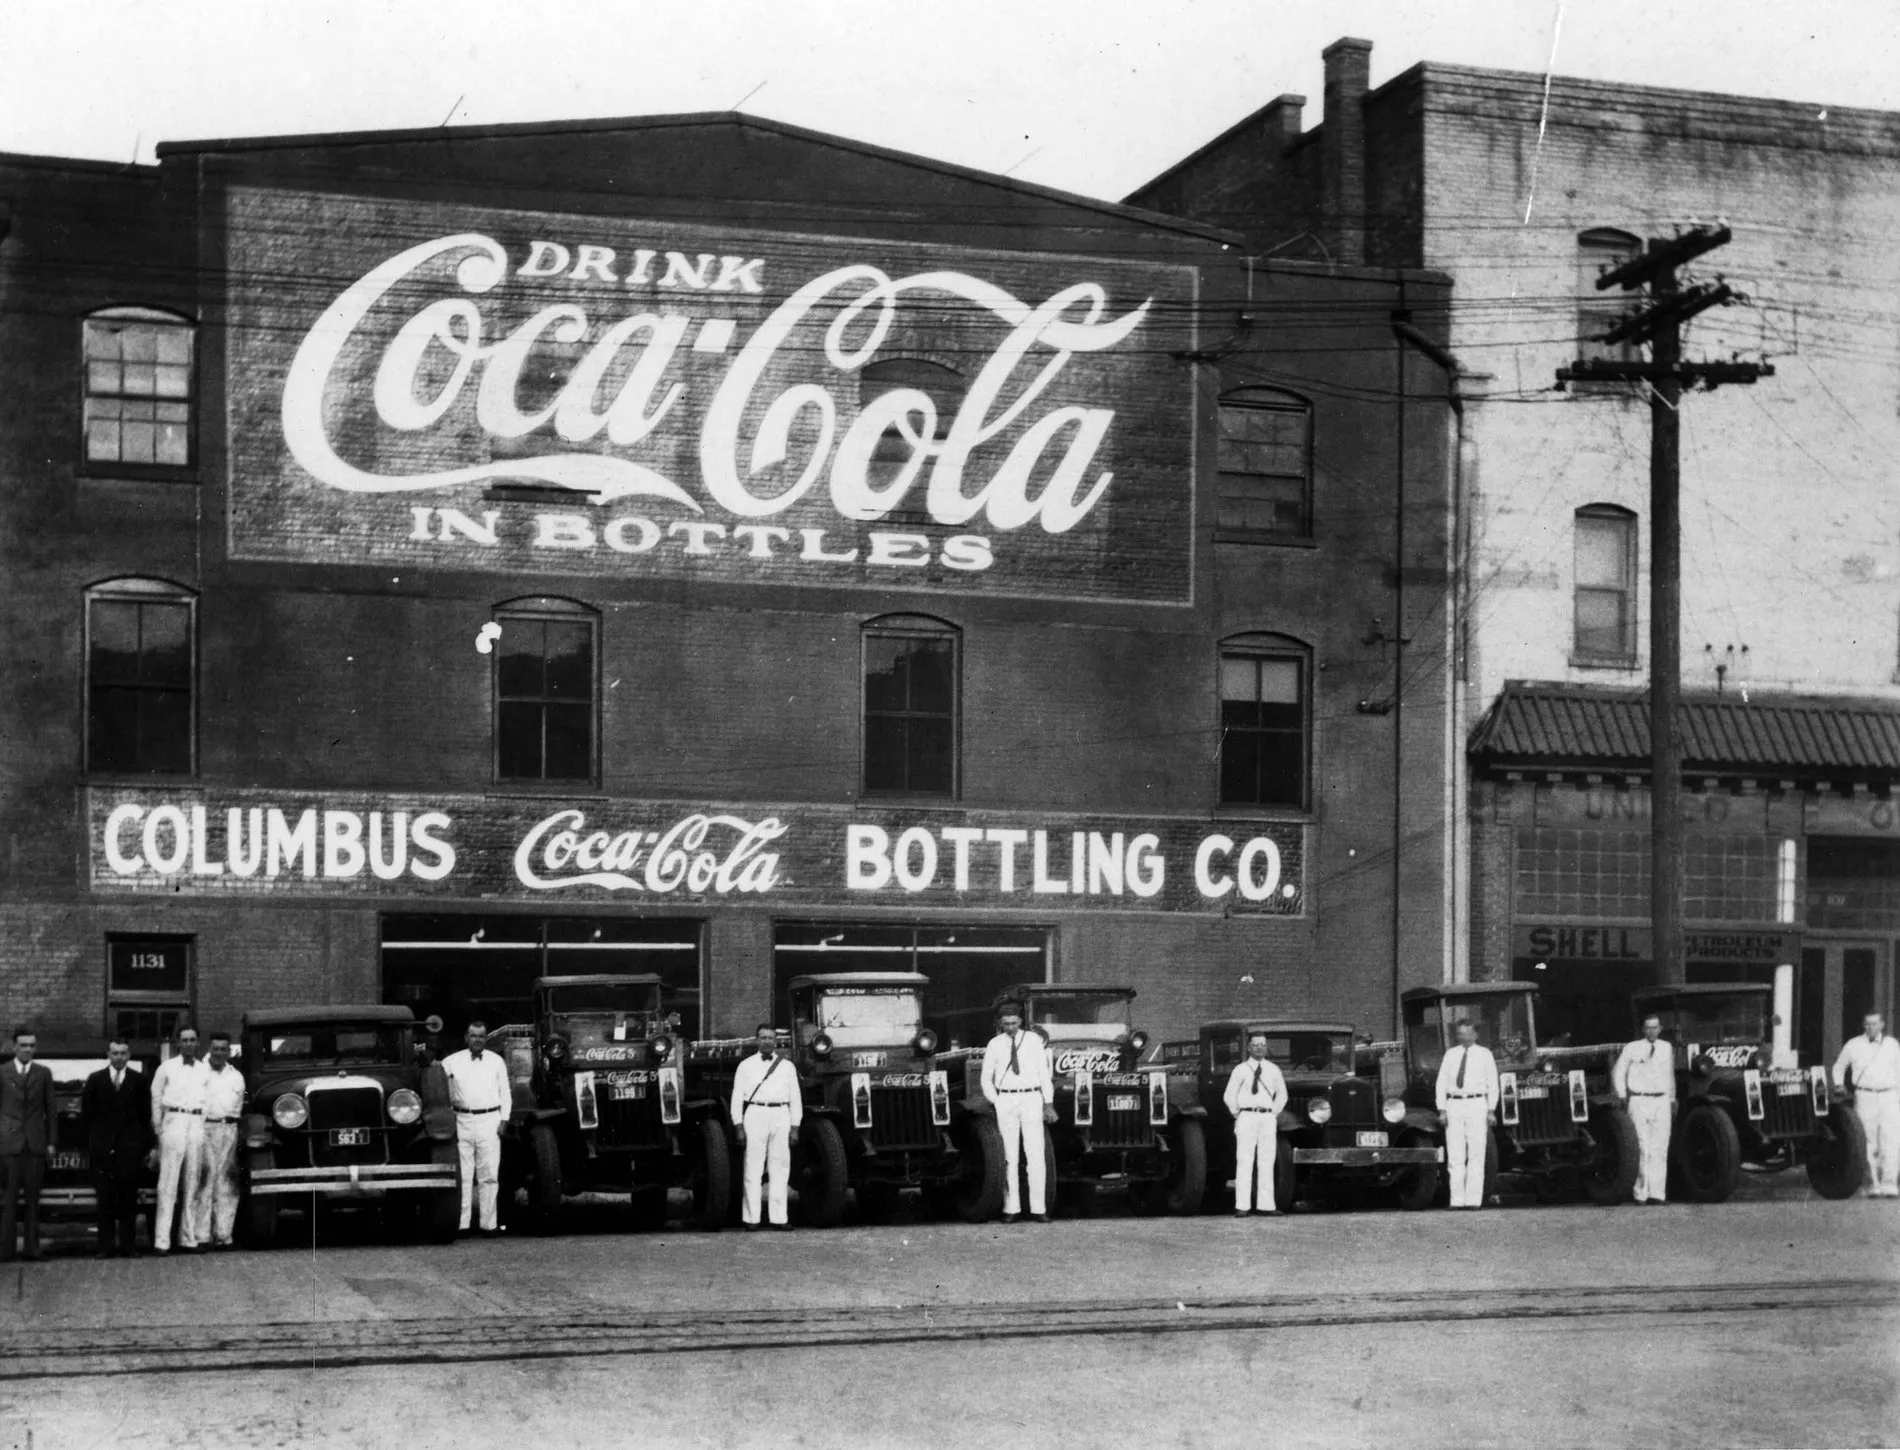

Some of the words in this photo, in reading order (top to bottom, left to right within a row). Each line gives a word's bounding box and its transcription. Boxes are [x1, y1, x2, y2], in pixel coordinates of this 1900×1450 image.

[518, 241, 765, 294] DRINK
[282, 233, 1153, 534] Coca-Cola
[409, 506, 500, 546] IN
[533, 514, 995, 571] BOTTLES
[103, 803, 457, 881] COLUMBUS
[514, 809, 789, 893] Coca-Cola
[847, 824, 1165, 897] BOTTLING
[1194, 834, 1296, 901] CO.
[131, 953, 166, 969] 1131
[1529, 926, 1640, 958] SHELL
[1055, 1047, 1121, 1073] Coca-Cola
